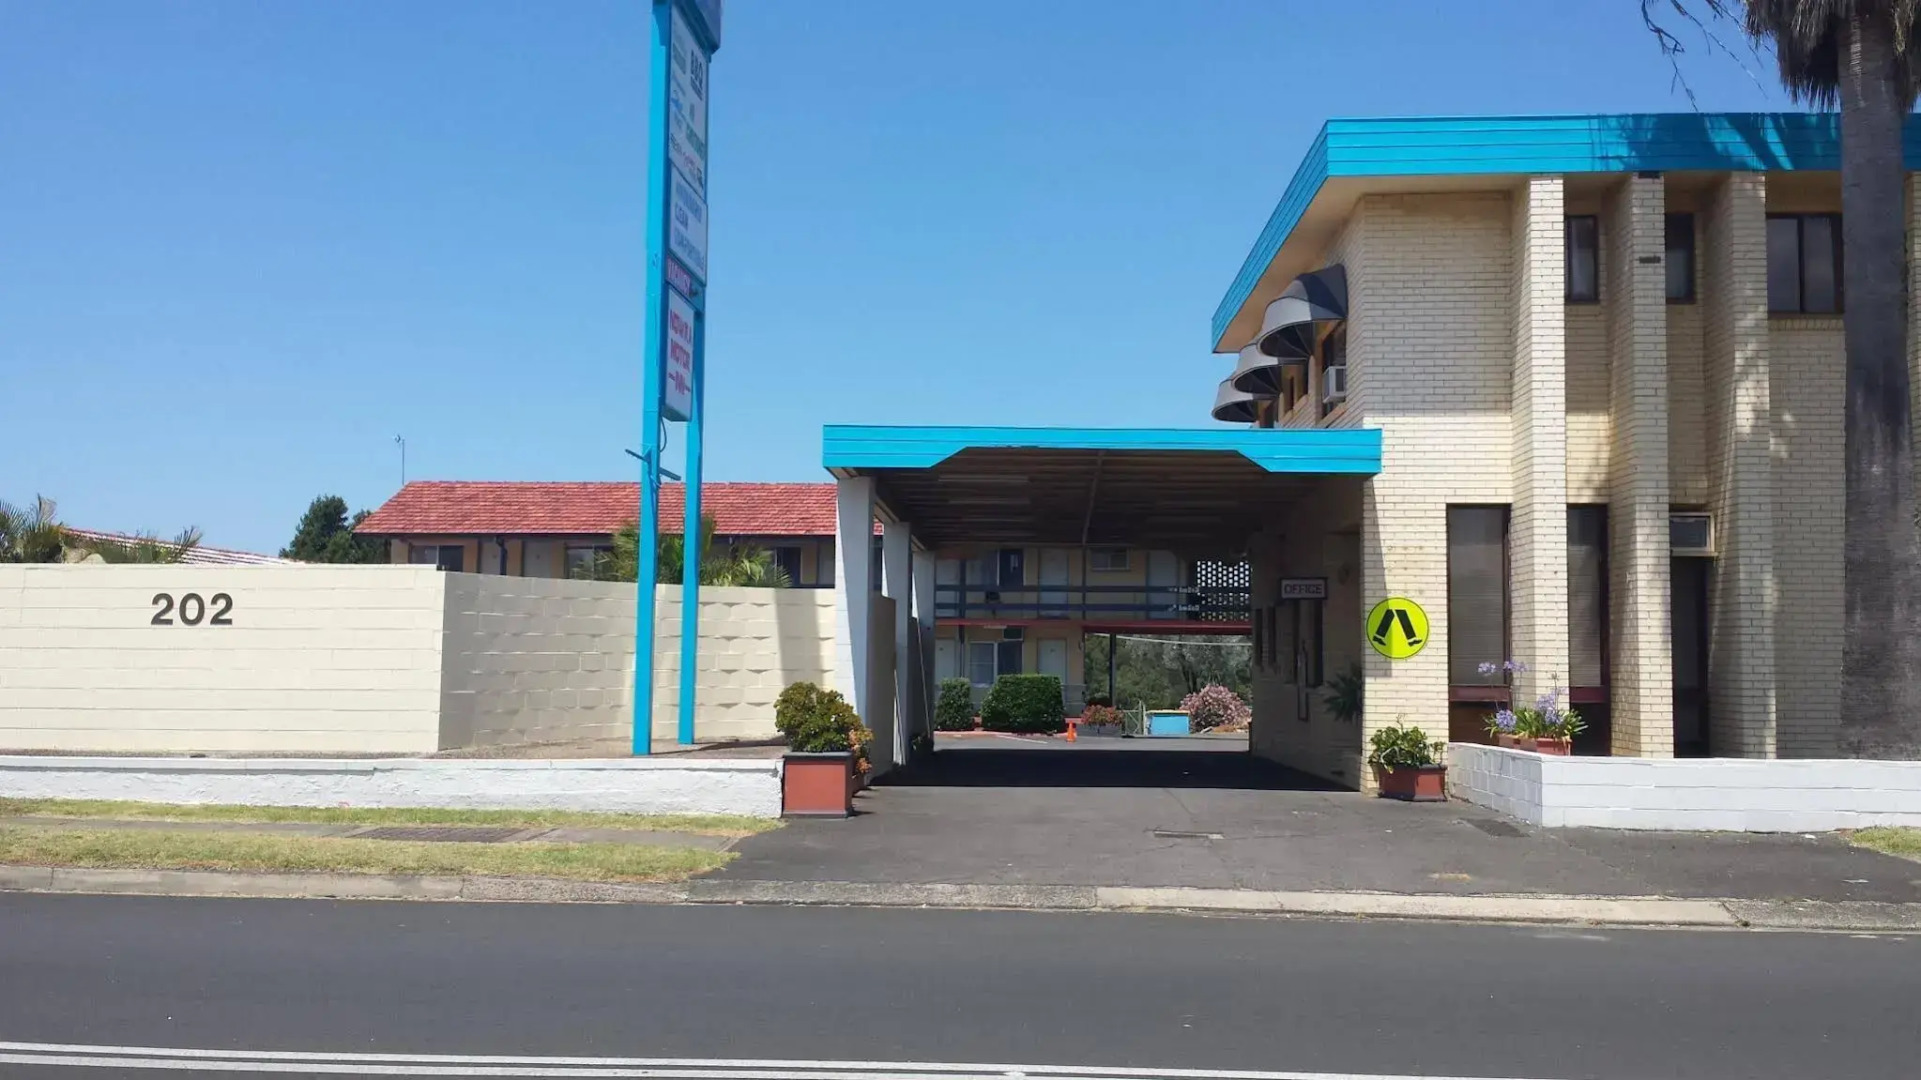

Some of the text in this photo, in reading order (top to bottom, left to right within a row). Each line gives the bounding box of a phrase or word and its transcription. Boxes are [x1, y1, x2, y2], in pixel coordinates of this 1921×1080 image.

[670, 339, 690, 373] MOTOR
[1284, 583, 1322, 594] OFFICE
[150, 592, 233, 626] 202
